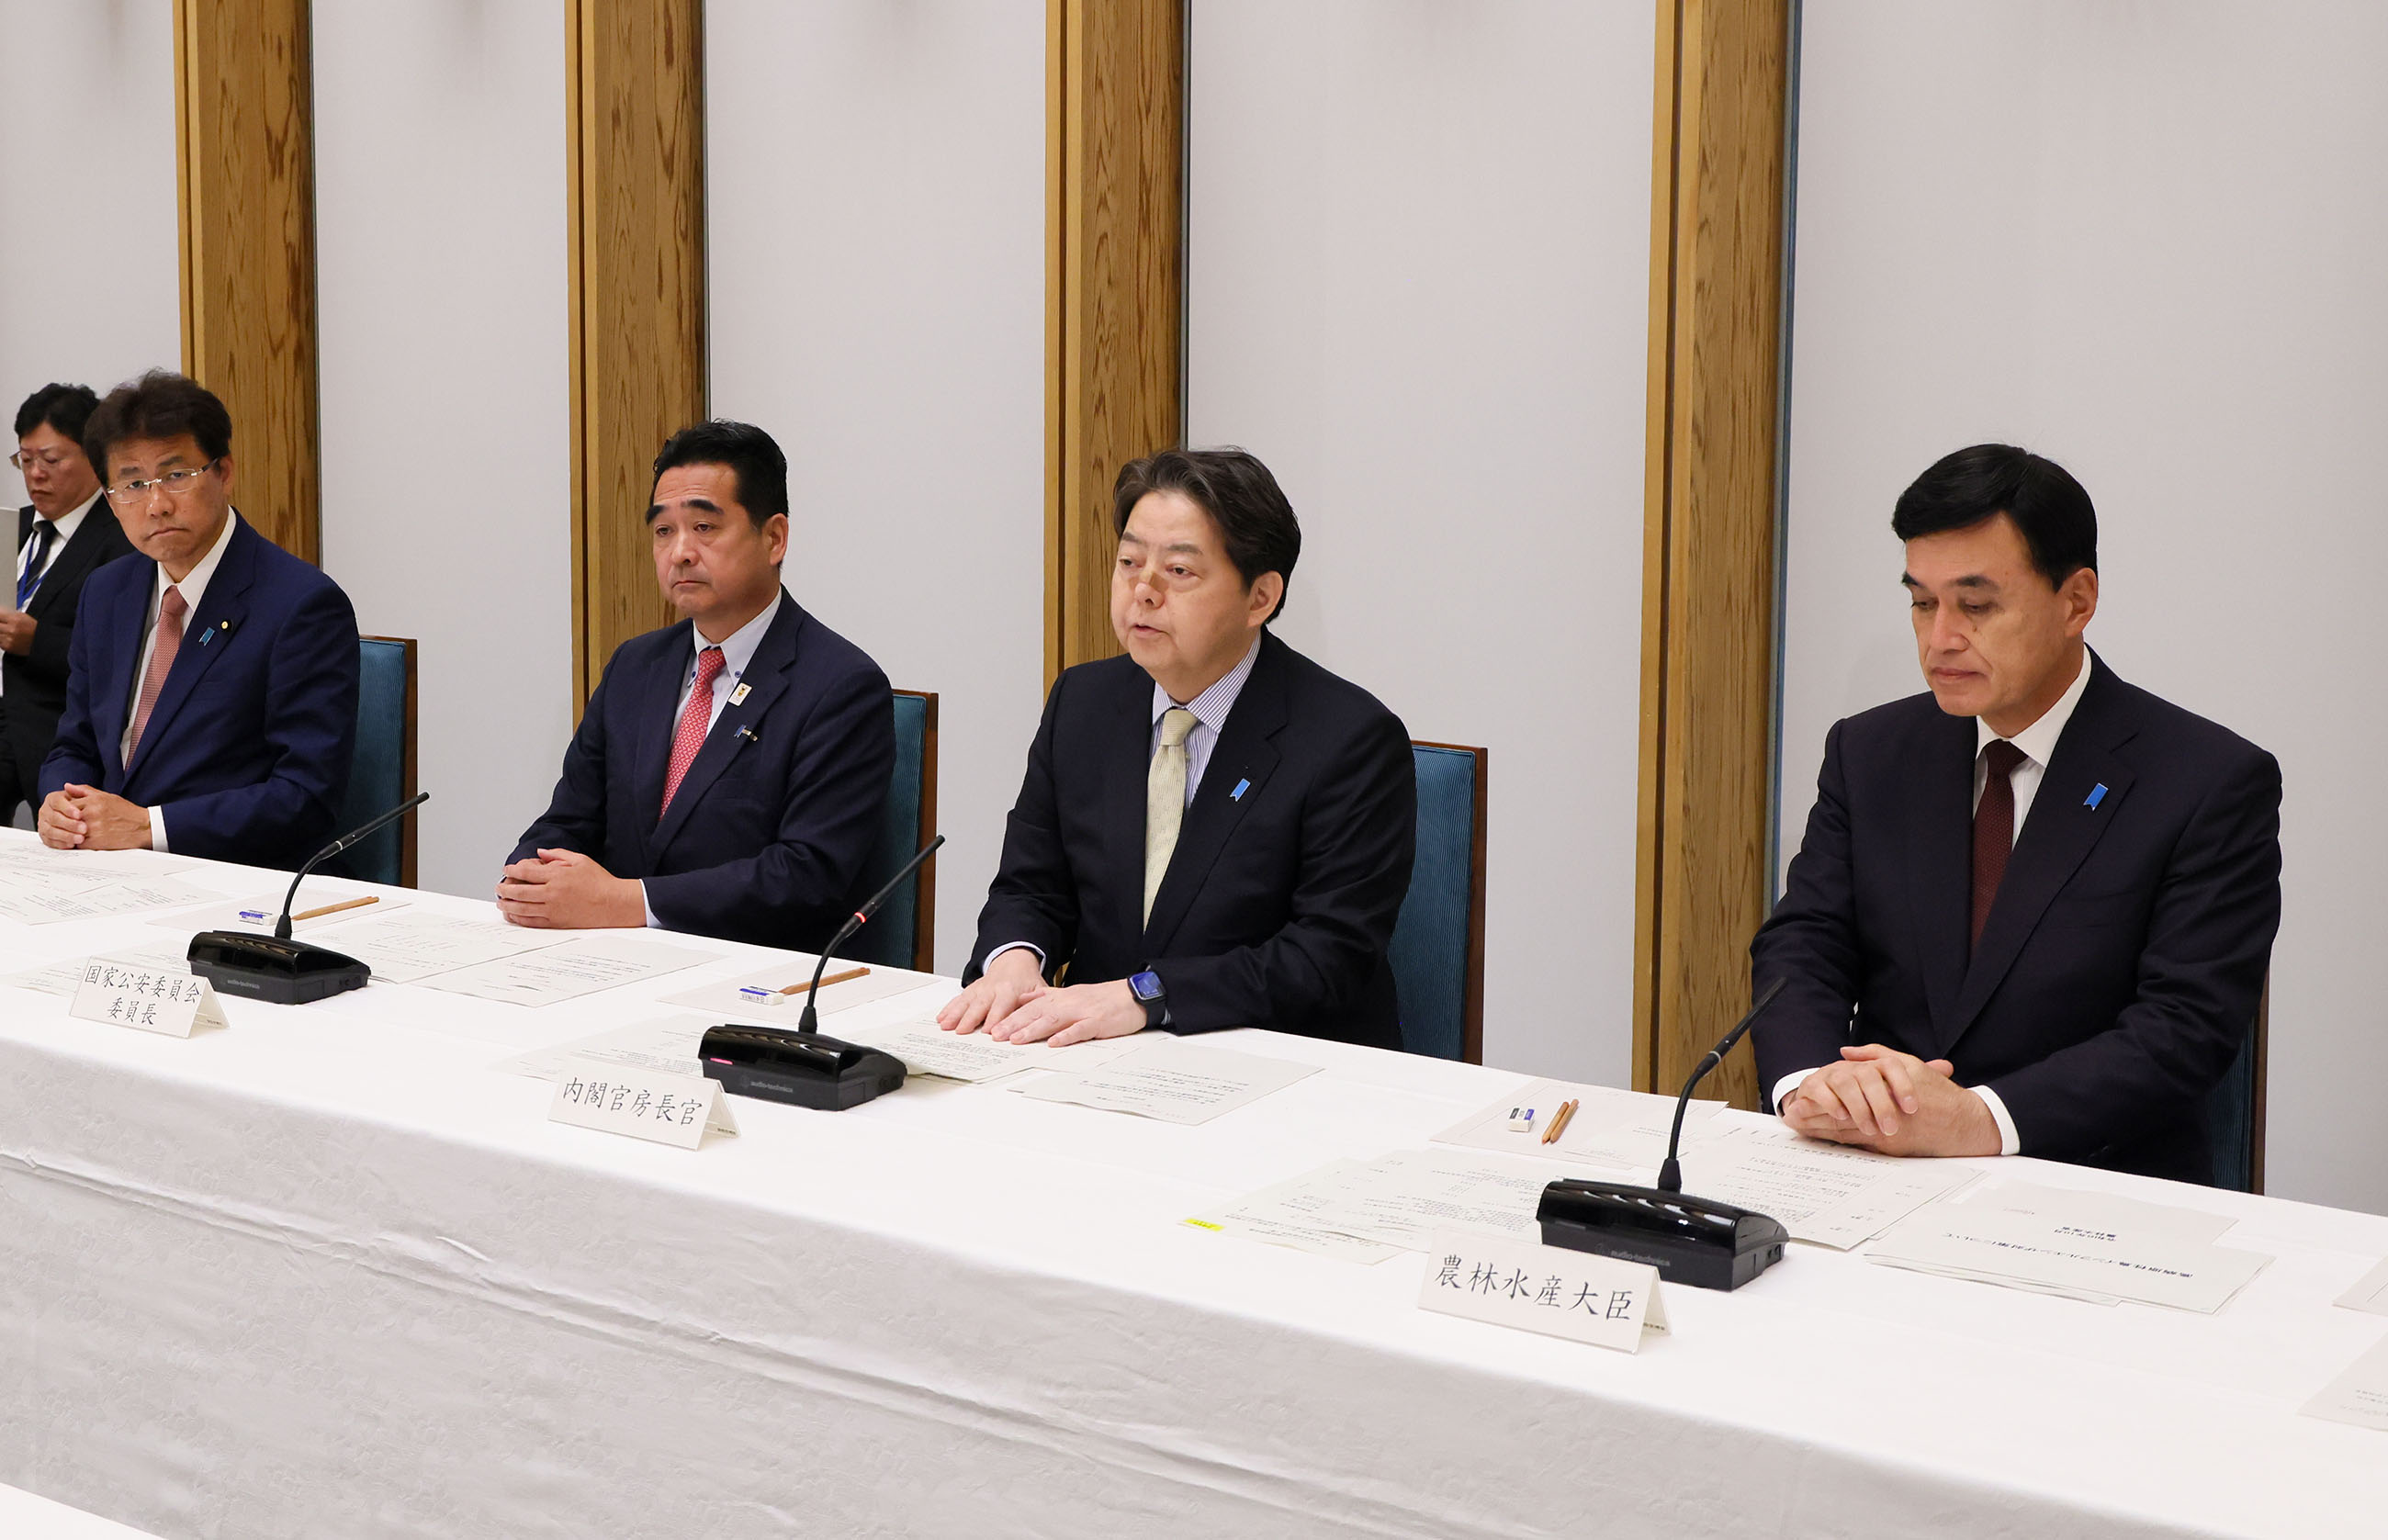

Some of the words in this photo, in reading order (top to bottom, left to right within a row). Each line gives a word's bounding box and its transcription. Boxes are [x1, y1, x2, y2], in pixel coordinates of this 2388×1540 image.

[85, 965, 201, 1004] 国家公安委員会
[107, 996, 157, 1025] 委員長
[562, 1076, 703, 1126] 内閣官房長官
[1435, 1253, 1633, 1321] 農林水産大臣
